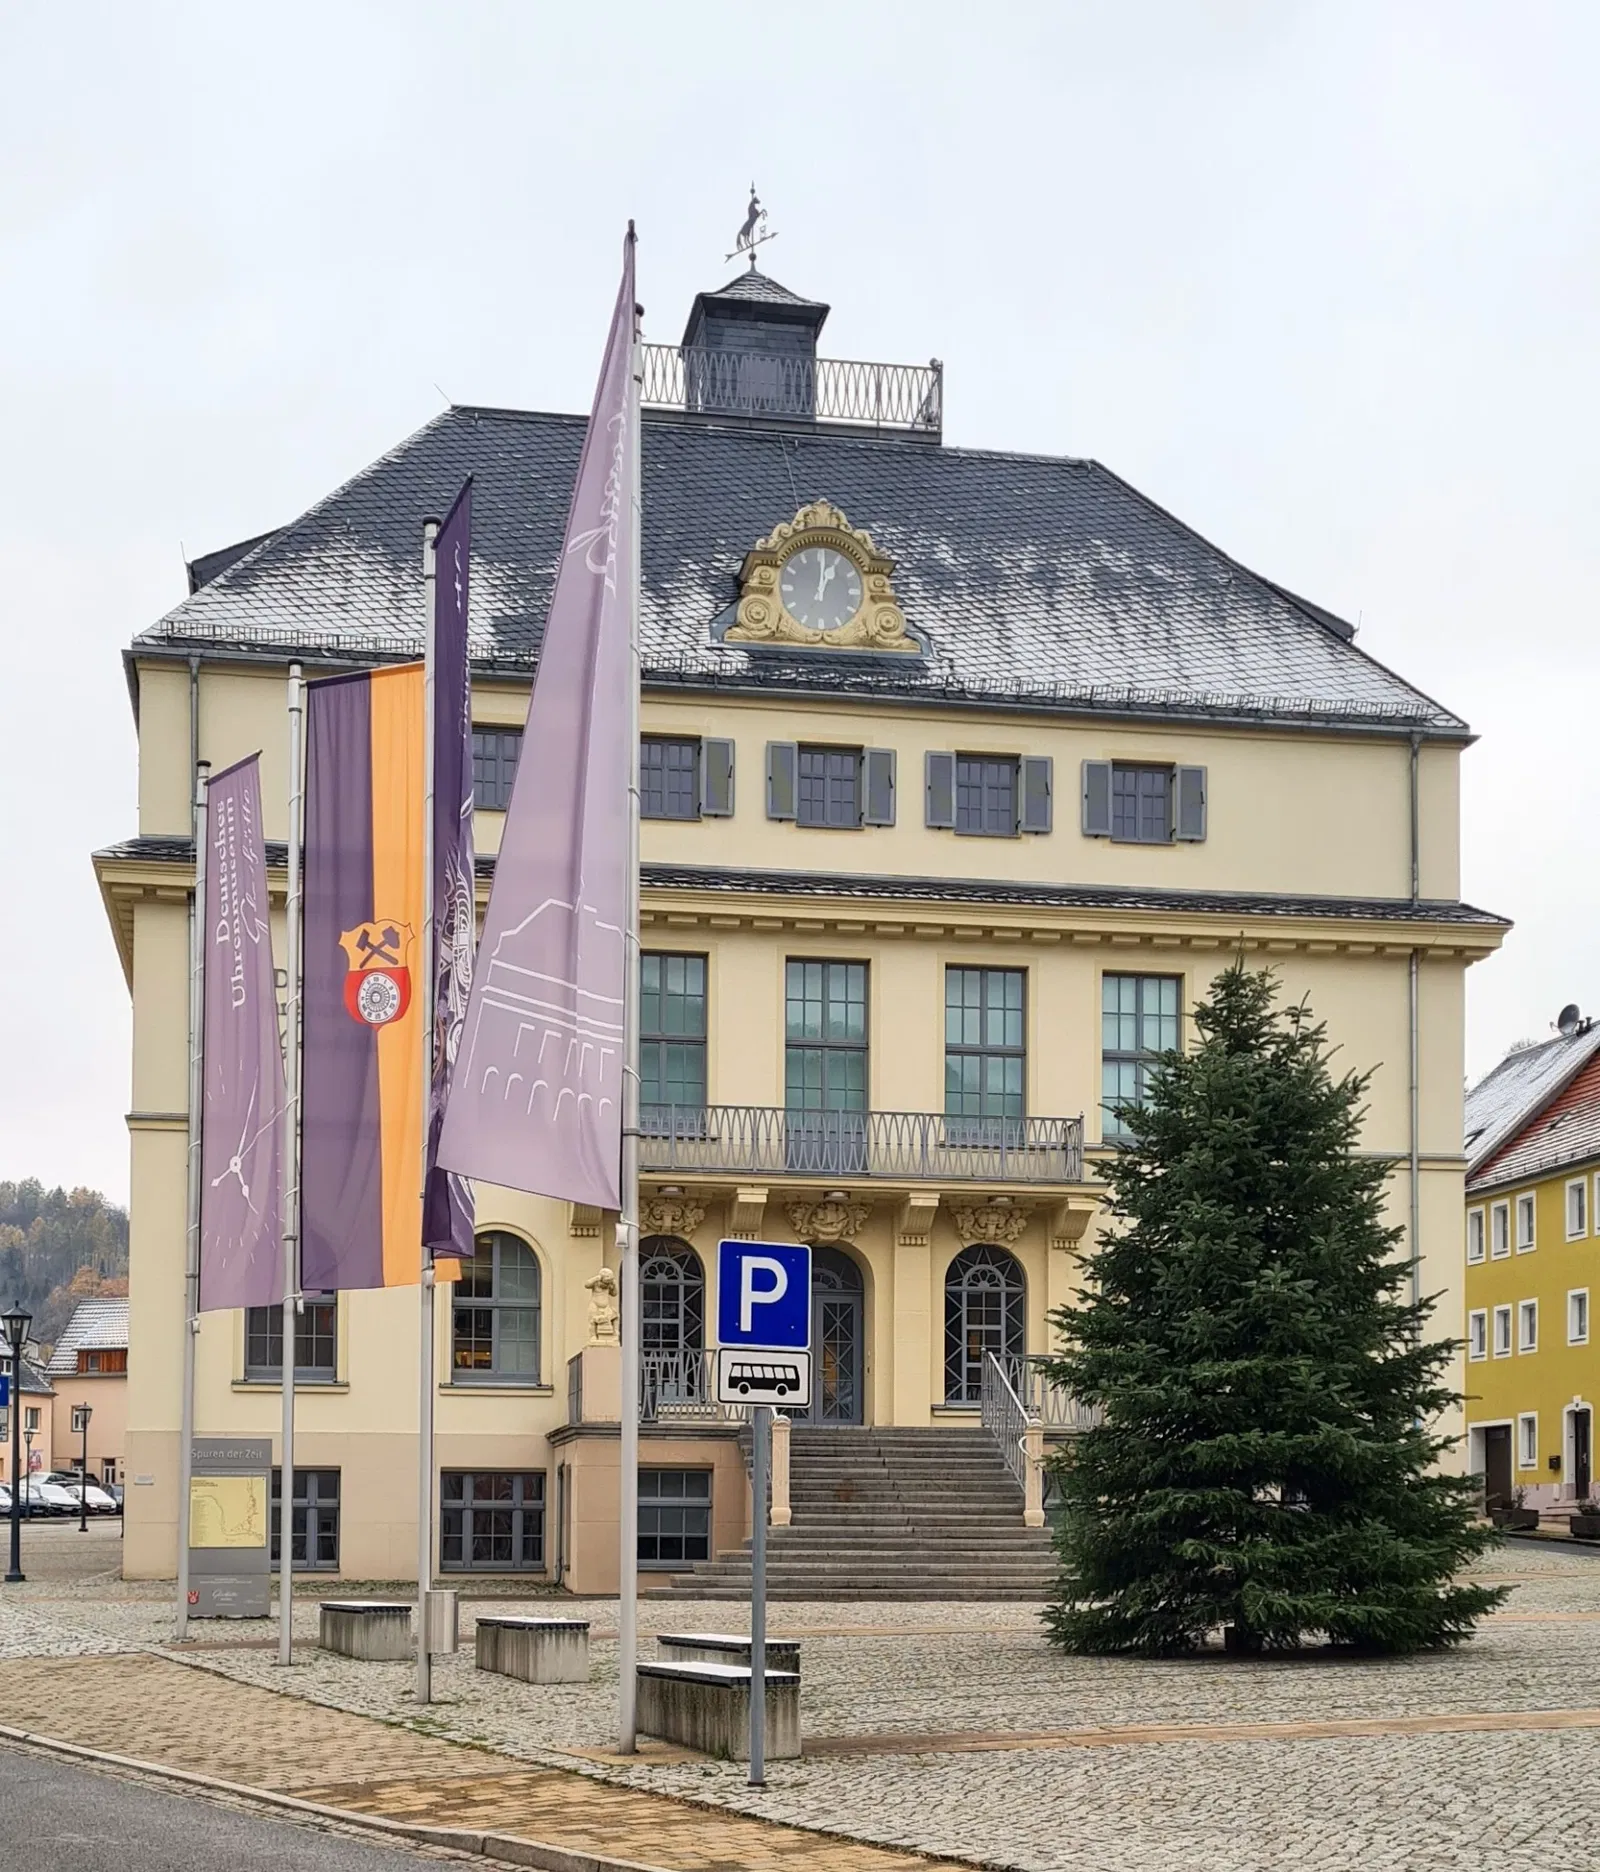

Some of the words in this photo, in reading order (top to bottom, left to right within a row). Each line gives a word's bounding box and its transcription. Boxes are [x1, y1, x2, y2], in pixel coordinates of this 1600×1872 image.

[214, 800, 230, 945] Deutsches
[226, 796, 246, 1010] Uhrenmuseum
[740, 1255, 788, 1332] P
[191, 1448, 224, 1460] Spuren
[226, 1449, 243, 1459] der
[244, 1448, 263, 1459] Zeit
